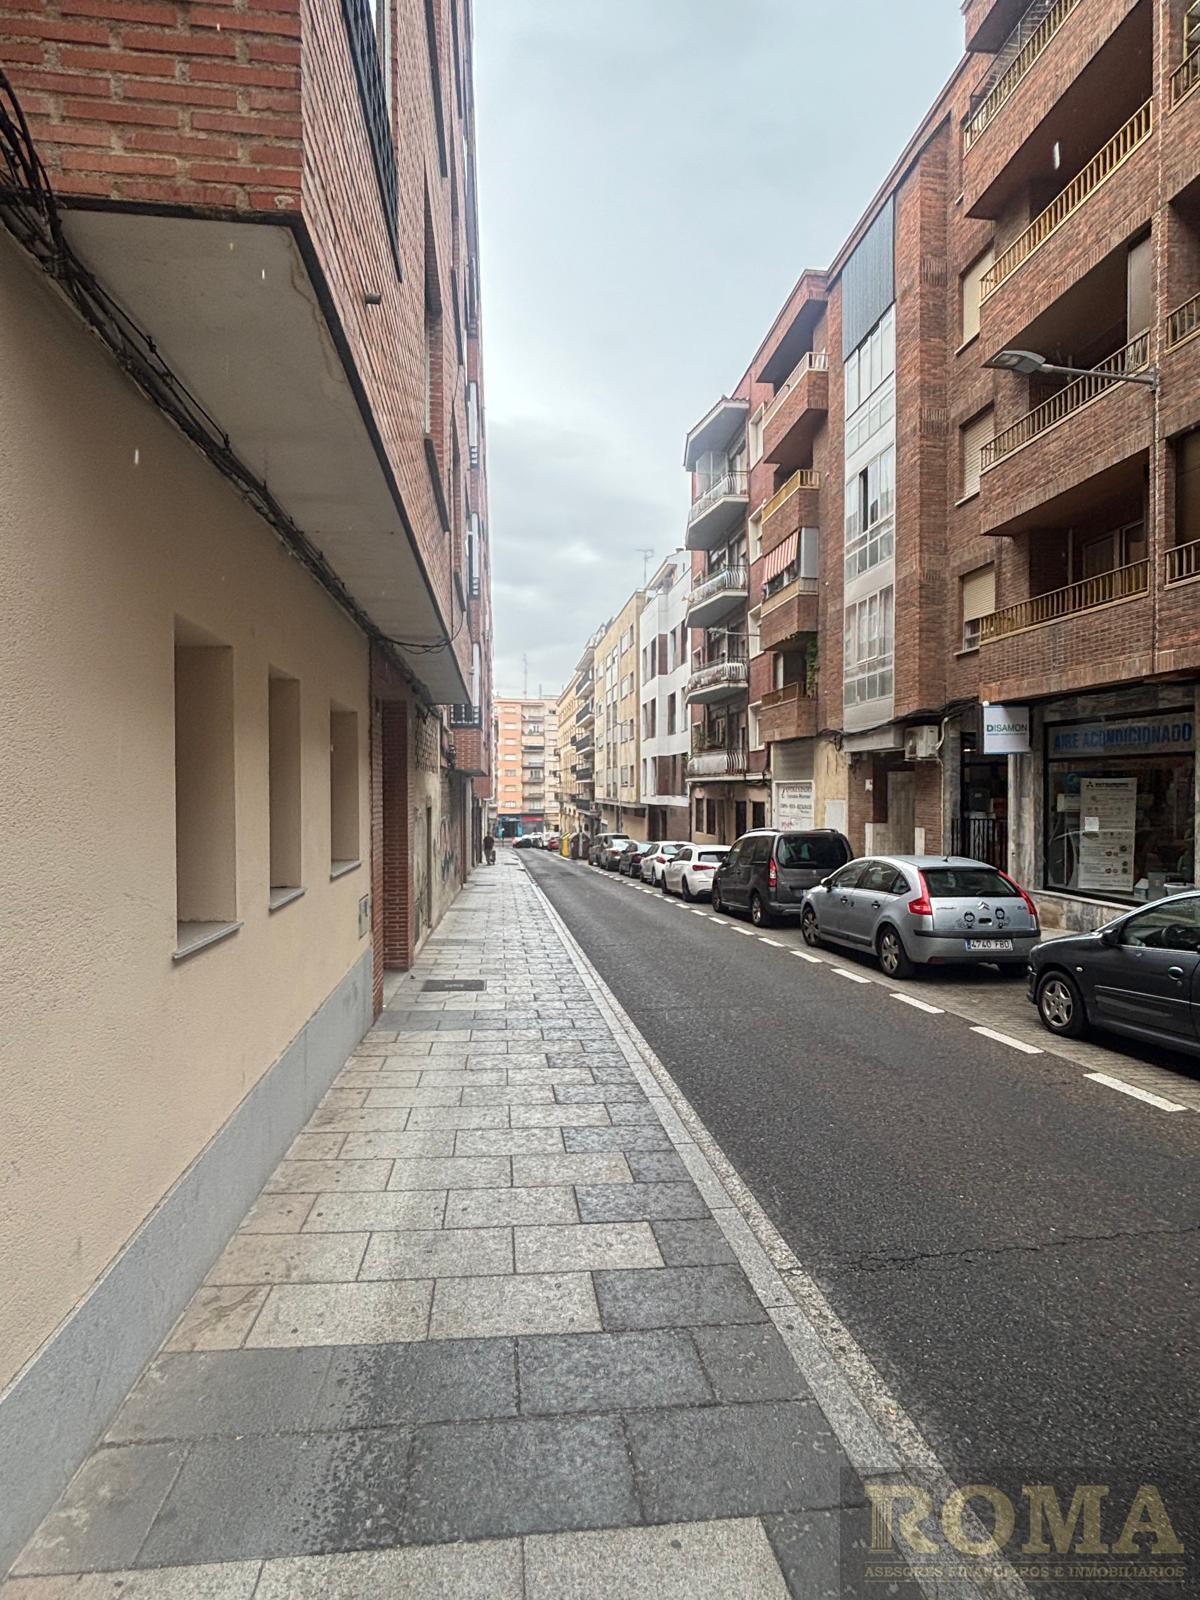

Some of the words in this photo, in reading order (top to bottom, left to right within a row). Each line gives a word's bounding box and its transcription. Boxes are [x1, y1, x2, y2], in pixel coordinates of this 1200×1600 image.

[986, 723, 1027, 732] DISAMON
[1055, 732, 1079, 747] AIRE
[1084, 723, 1192, 746] ACONDICIONADO
